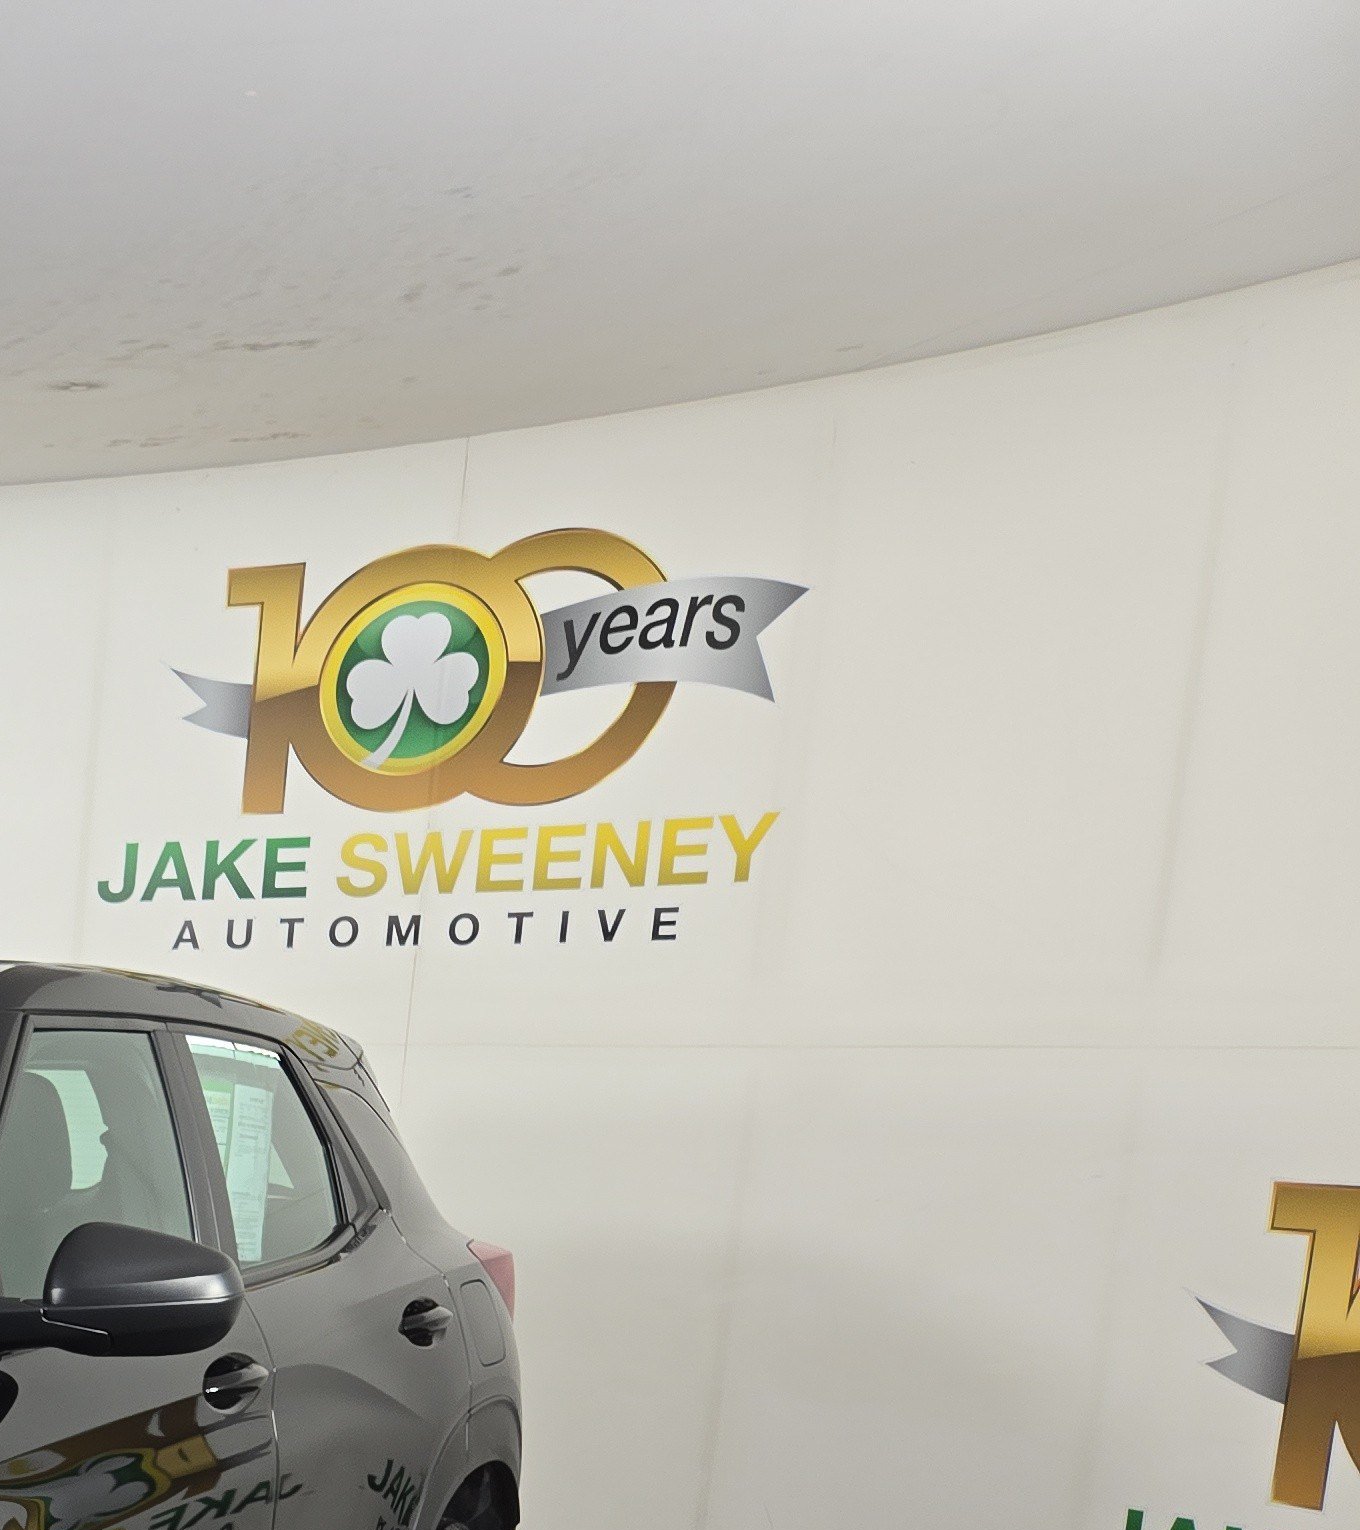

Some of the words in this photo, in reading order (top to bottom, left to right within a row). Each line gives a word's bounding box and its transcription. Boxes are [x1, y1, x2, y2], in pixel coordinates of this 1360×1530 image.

[554, 592, 746, 681] years
[96, 836, 311, 904] JAKE
[335, 811, 780, 899] SWEENEY
[172, 906, 680, 951] AUTOMOTIVE
